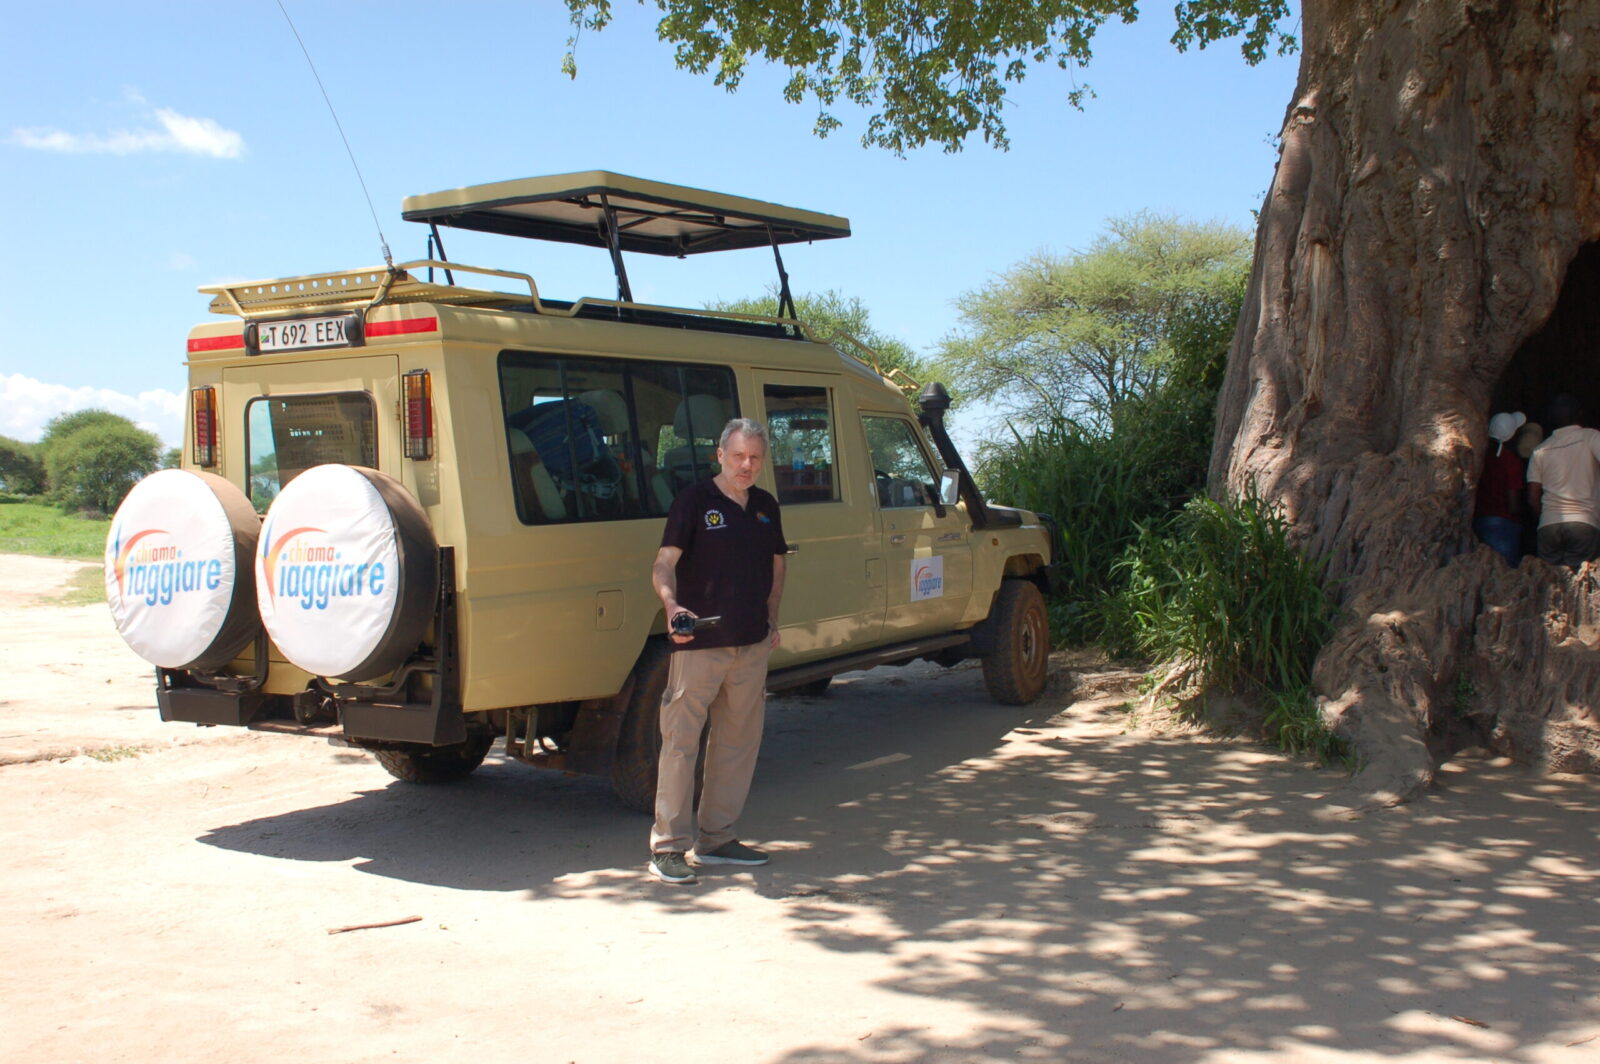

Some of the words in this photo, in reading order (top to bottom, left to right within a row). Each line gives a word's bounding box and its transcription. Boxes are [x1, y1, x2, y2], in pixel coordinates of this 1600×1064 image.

[269, 326, 277, 346] T
[281, 323, 307, 345] 692
[316, 320, 345, 342] EEX
[135, 542, 177, 562] chiama
[289, 540, 335, 562] chiama
